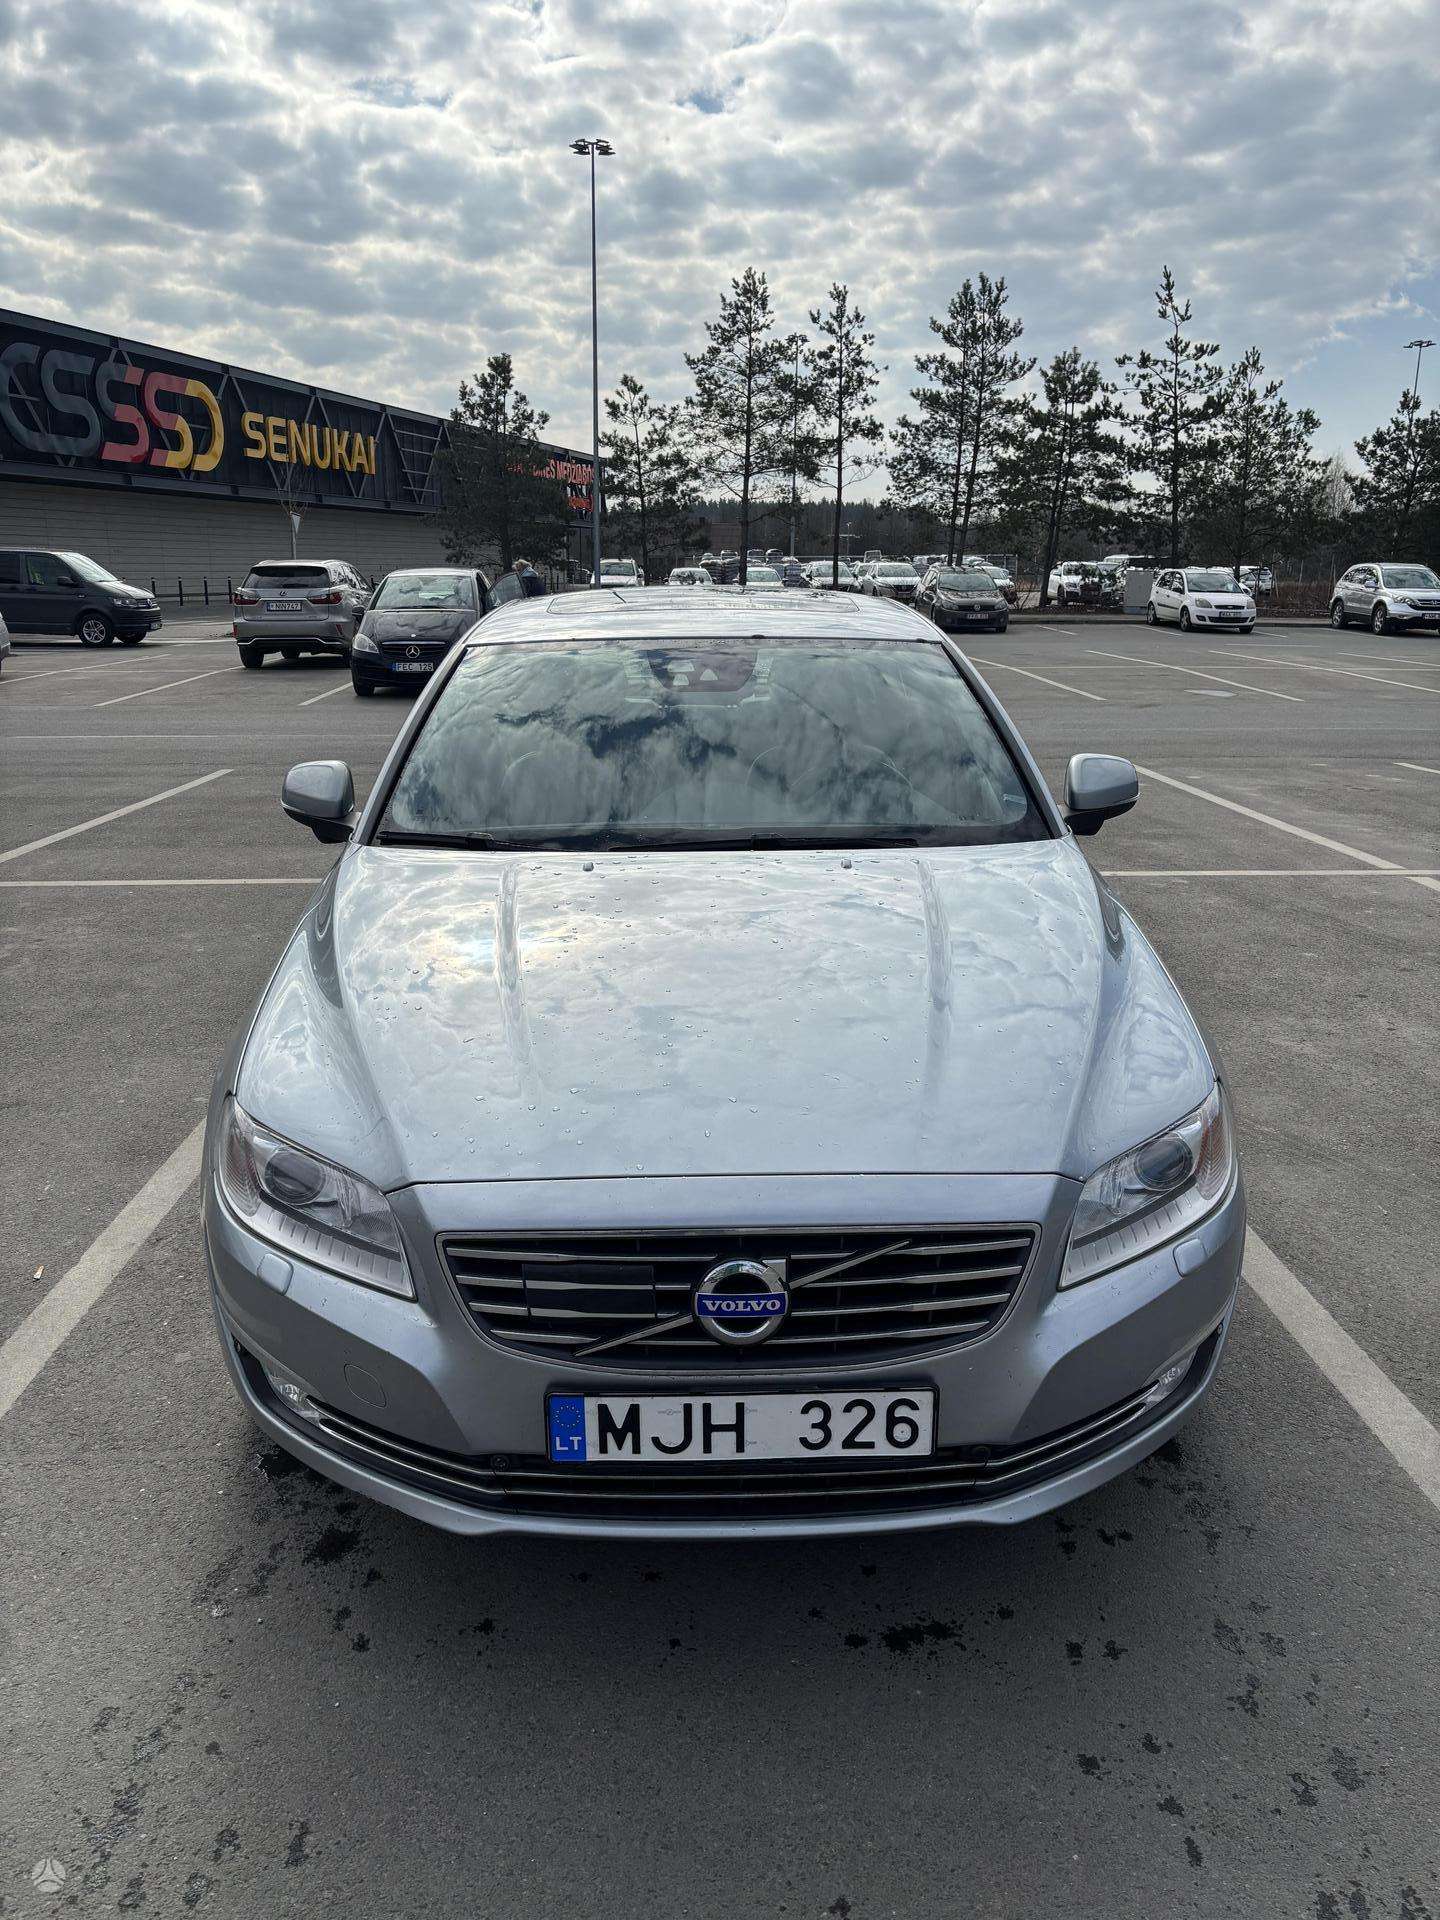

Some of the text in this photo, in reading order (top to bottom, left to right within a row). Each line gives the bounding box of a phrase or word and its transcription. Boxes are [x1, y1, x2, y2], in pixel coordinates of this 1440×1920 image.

[241, 411, 376, 475] SENUKAI
[702, 1299, 781, 1312] VOLVO
[555, 1436, 582, 1451] LT
[598, 1398, 920, 1455] MJH 326
